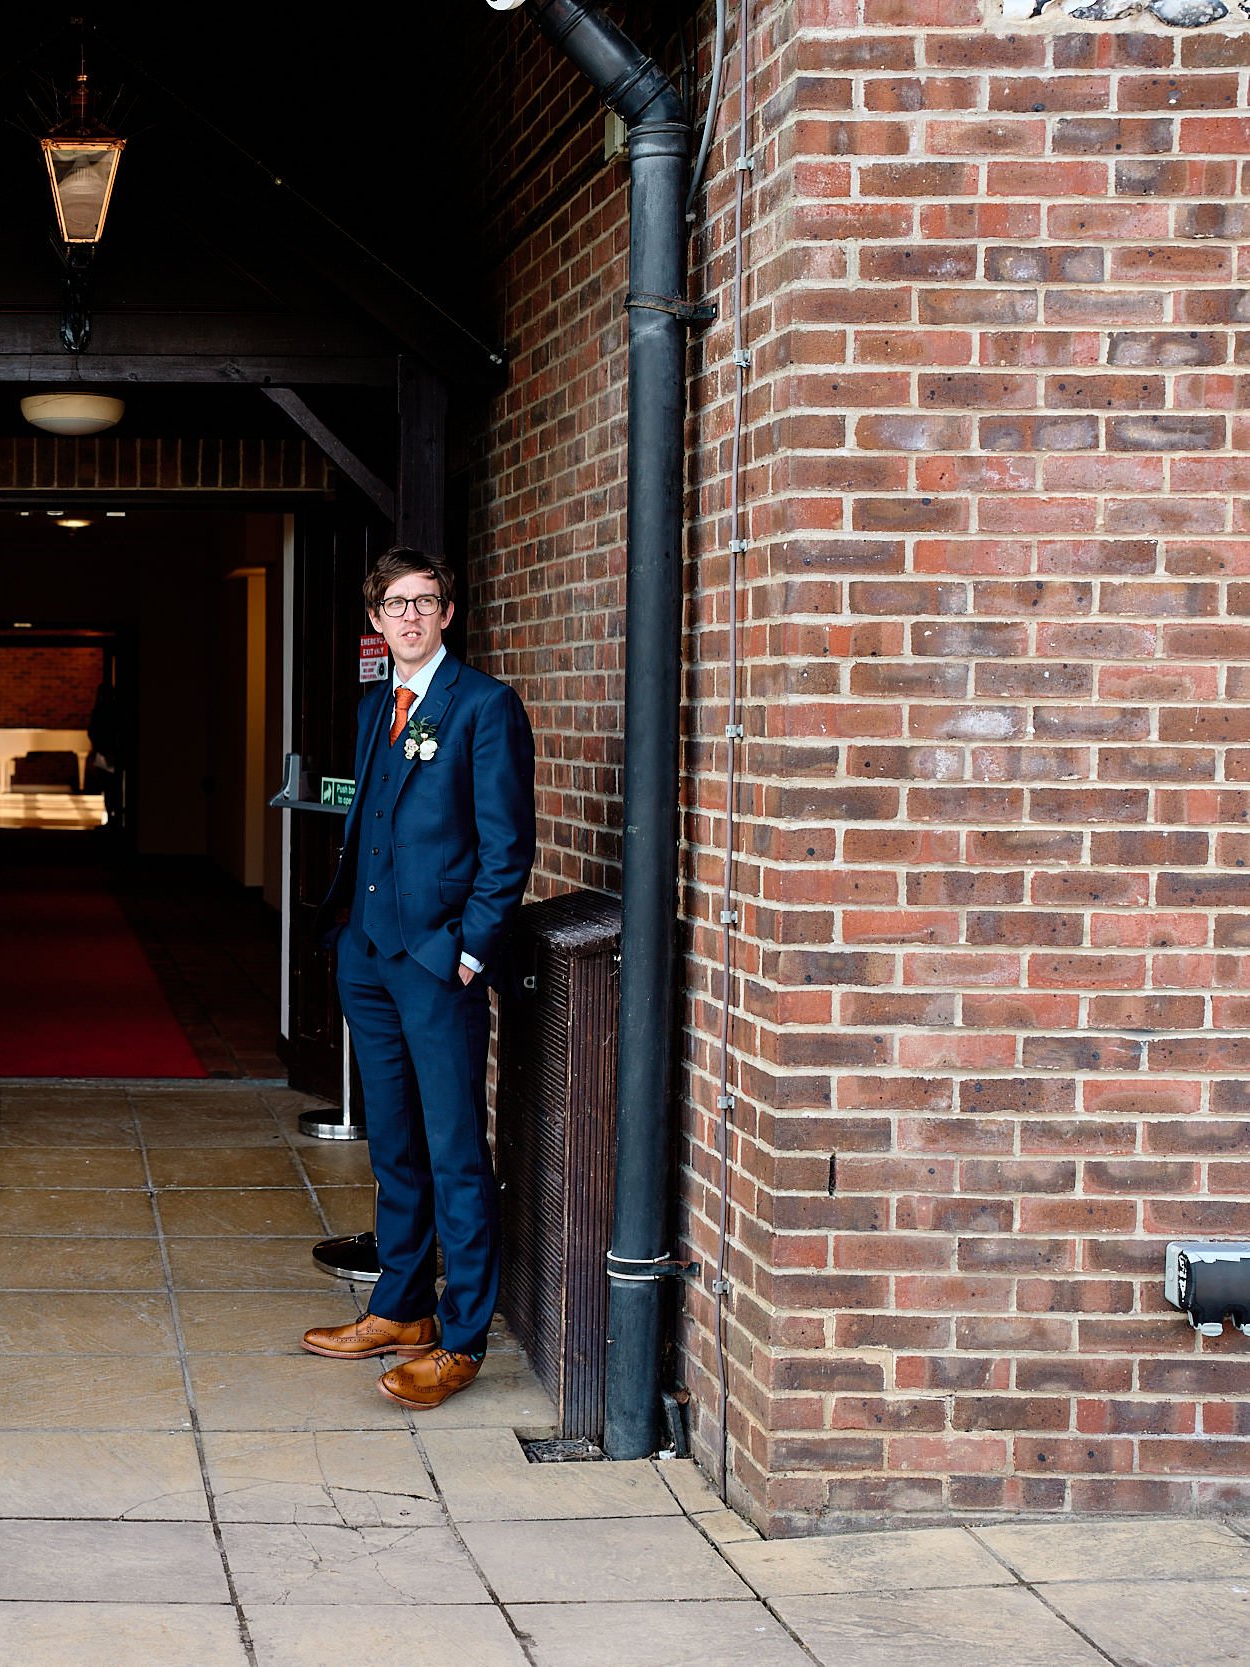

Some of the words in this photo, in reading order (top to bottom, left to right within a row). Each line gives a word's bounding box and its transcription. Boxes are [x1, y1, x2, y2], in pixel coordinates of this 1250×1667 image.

[336, 784, 348, 794] Push
[338, 795, 343, 804] to
[343, 797, 352, 807] ope
